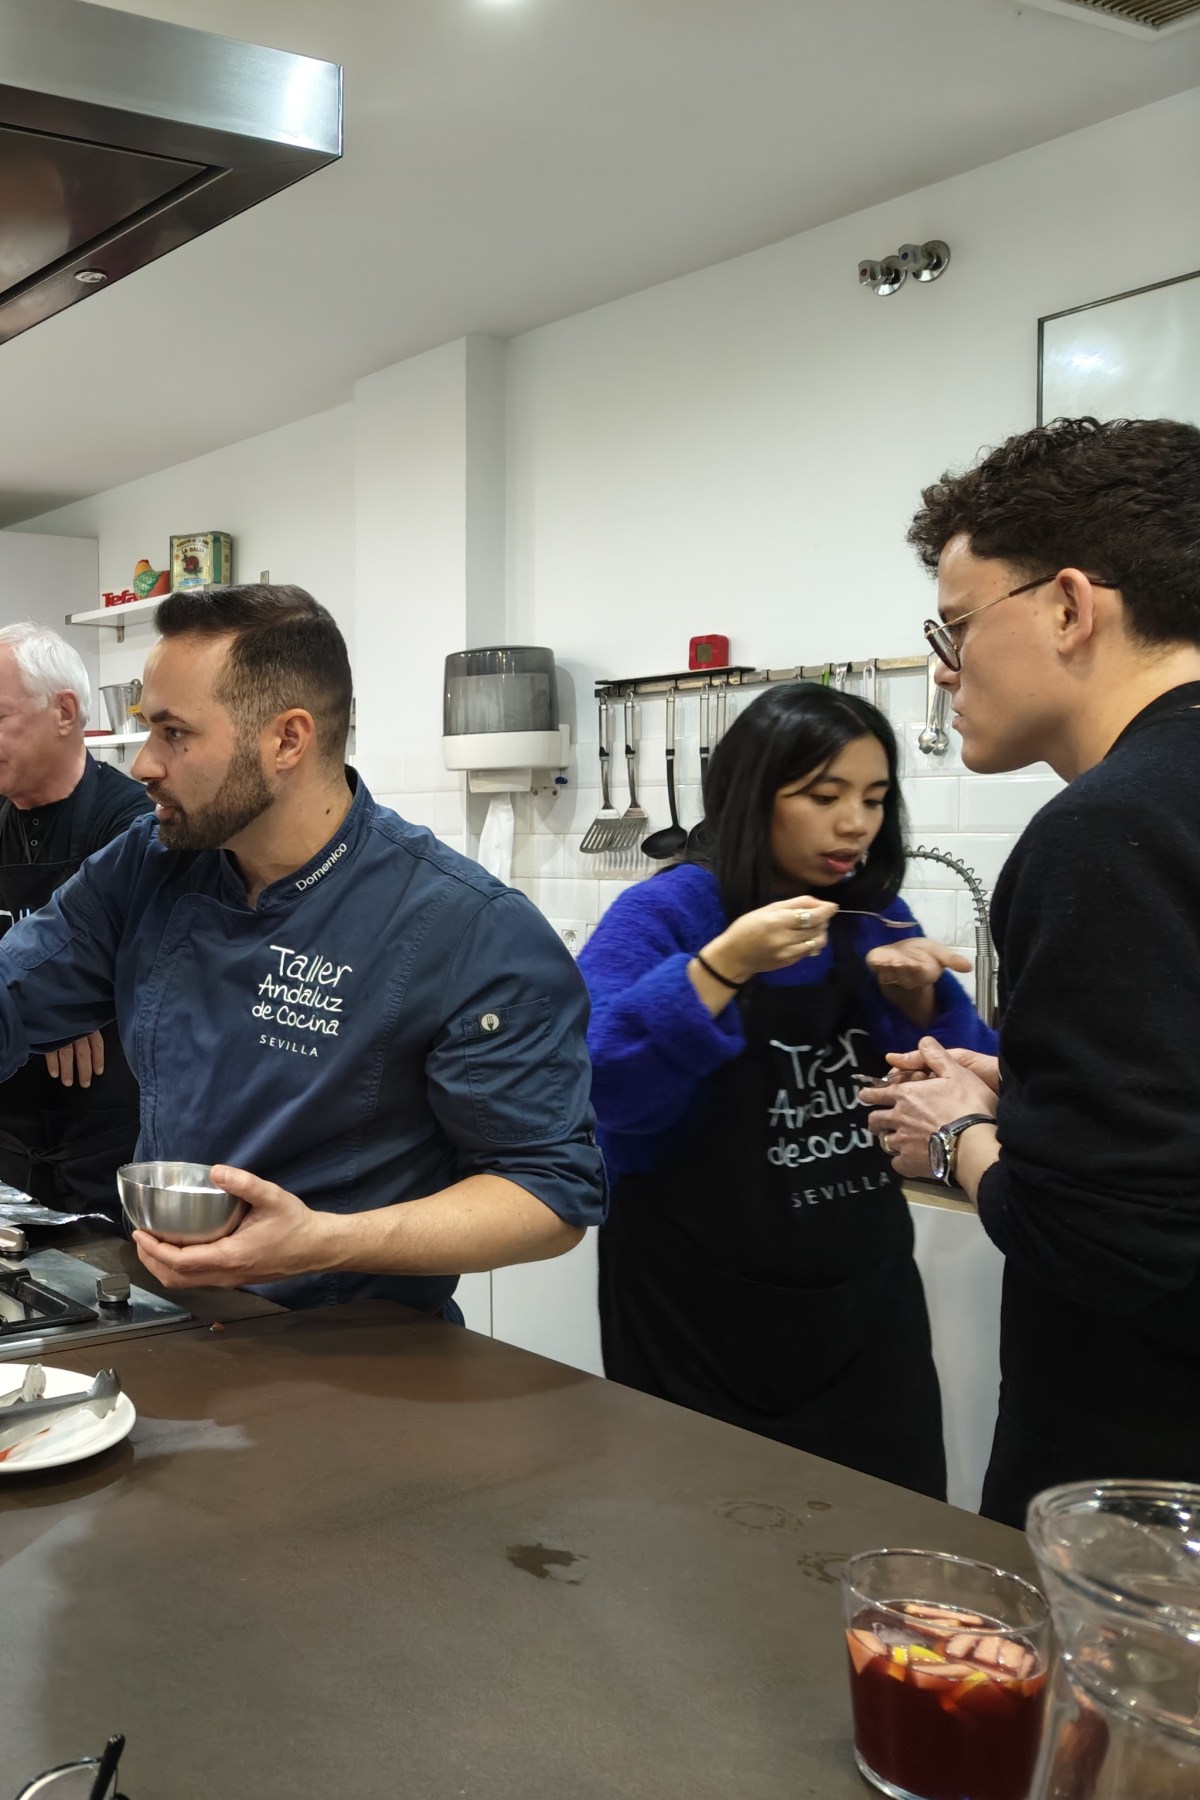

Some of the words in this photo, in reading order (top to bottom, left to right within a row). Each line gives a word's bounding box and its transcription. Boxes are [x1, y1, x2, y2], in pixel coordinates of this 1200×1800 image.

[295, 842, 347, 892] Domenico
[270, 945, 353, 988] Taller
[258, 973, 344, 1013] Andaluz
[252, 1001, 275, 1020] de
[276, 1005, 340, 1036] Cocina
[259, 1034, 319, 1058] SEVILLA
[767, 1136, 800, 1168] de
[791, 1171, 891, 1209] SEVILLA
